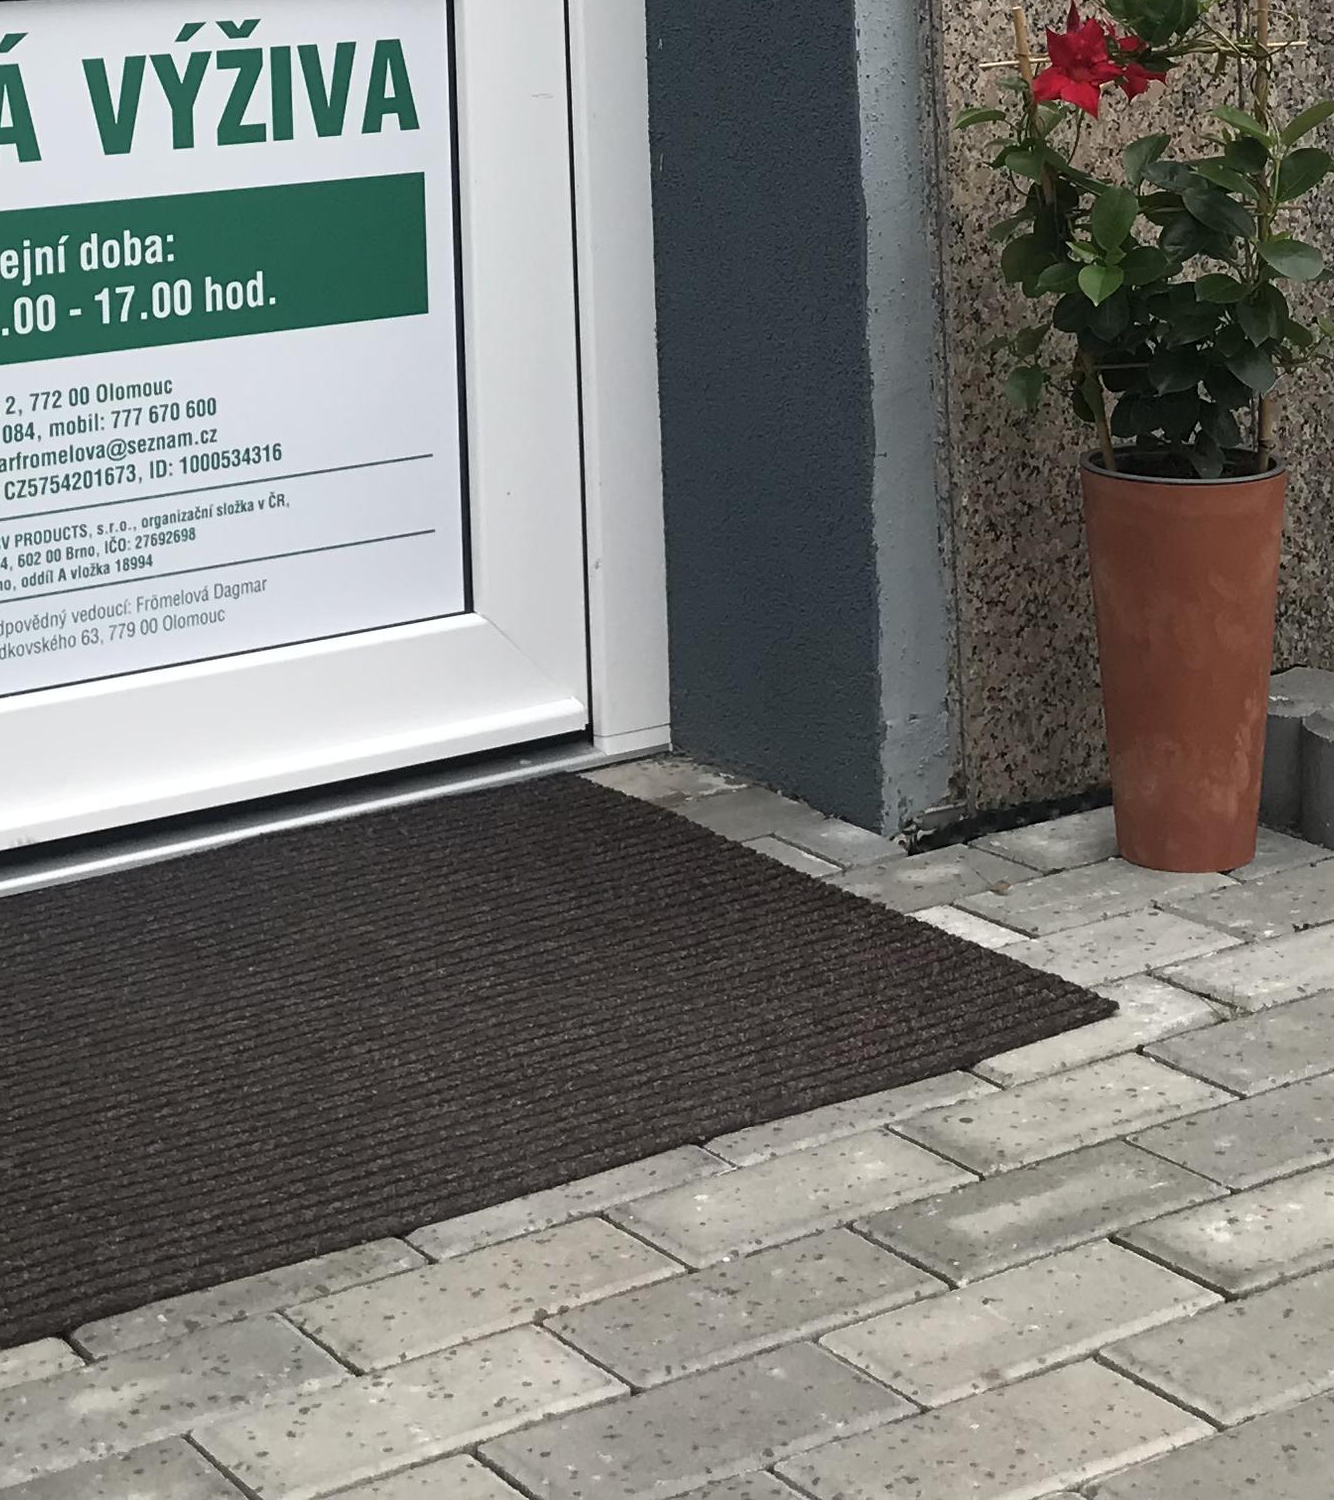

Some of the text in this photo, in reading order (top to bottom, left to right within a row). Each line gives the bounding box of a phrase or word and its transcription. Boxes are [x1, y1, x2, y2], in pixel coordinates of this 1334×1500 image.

[81, 18, 421, 156] VÝŽIVA
[79, 229, 175, 272] doba:
[94, 278, 193, 325] 17.00
[204, 270, 276, 313] hod.
[2, 421, 42, 444] 084,
[49, 412, 105, 438] mobil:
[110, 407, 143, 429] 777
[148, 402, 181, 424] 670
[185, 397, 217, 419] 600
[5, 395, 23, 417] 2,
[29, 389, 63, 412] 772
[68, 386, 90, 407] 00
[96, 379, 173, 404] Olomouc
[4, 463, 143, 501] CZ5754201673,
[149, 459, 173, 480] ID:
[179, 442, 283, 475] 1000534316
[141, 503, 214, 530] organizační
[216, 499, 255, 517] složka
[257, 499, 265, 511] v
[17, 550, 42, 569] 602
[45, 547, 62, 564] 00
[104, 535, 131, 555] IČO:
